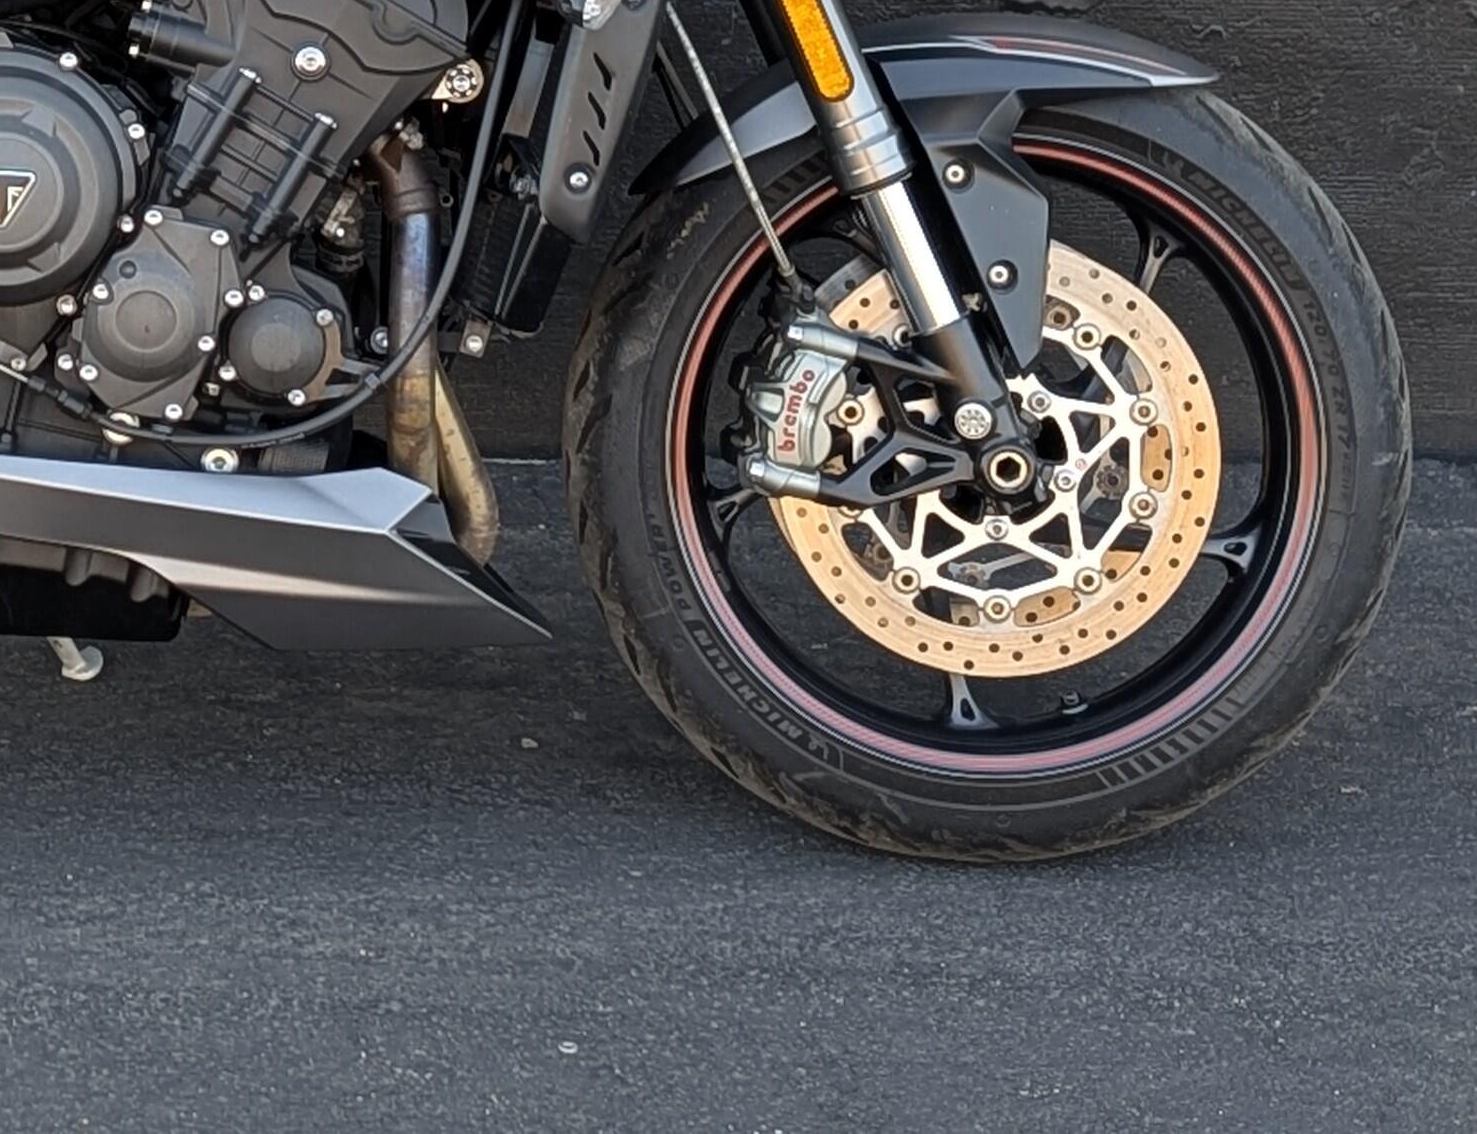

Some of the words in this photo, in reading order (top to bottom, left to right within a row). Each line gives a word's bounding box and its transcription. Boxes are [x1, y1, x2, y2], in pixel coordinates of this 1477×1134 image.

[1190, 169, 1302, 286] MICHELIN
[778, 369, 816, 452] brembo
[650, 523, 692, 612] POWER
[692, 627, 805, 742] MICHELIN
